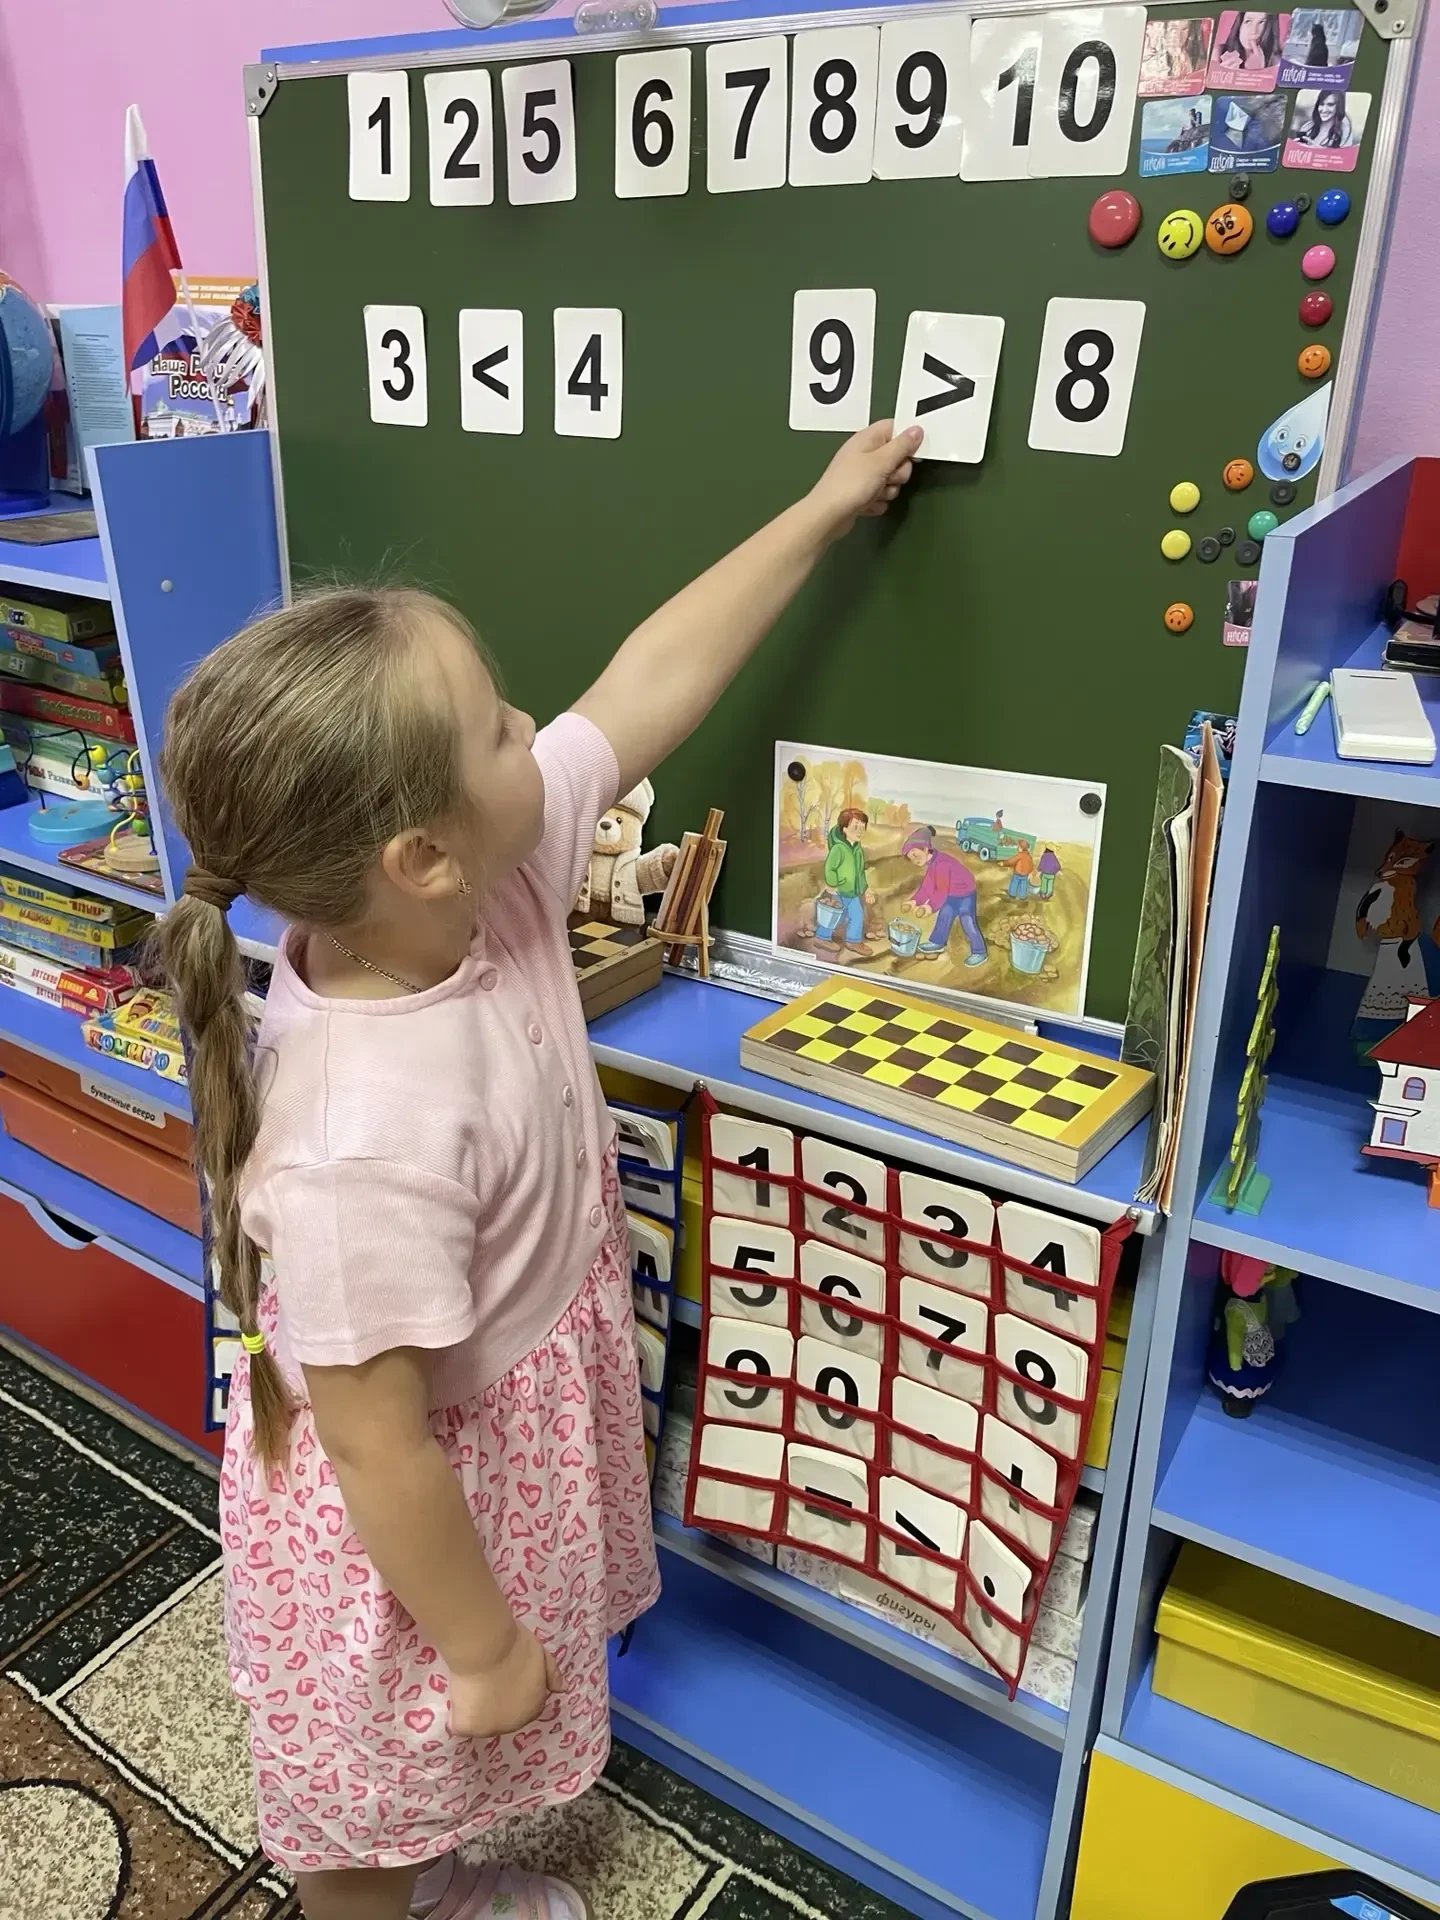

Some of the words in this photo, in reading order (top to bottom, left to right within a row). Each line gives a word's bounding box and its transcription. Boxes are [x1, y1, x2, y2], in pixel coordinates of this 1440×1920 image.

[367, 96, 392, 175] 1
[443, 98, 481, 179] 2
[521, 88, 562, 174] 5
[631, 78, 674, 167] 6
[724, 67, 771, 160] 7
[809, 58, 857, 153] 8
[894, 50, 948, 148] 9
[152, 353, 187, 376] Наша
[170, 374, 228, 400] Росся
[381, 328, 415, 401] 3
[567, 333, 609, 412] 4
[808, 318, 856, 405] 9
[1055, 328, 1115, 423] 8
[89, 1029, 170, 1071] ДОМИНО
[90, 1085, 131, 1111] буквенные
[738, 1146, 771, 1208] 1
[822, 1171, 868, 1240] 2
[919, 1204, 969, 1269] 3
[1022, 1241, 1078, 1312] 4
[729, 1246, 777, 1308] 5
[818, 1274, 863, 1337] 6
[918, 1304, 967, 1371] 7
[723, 1349, 772, 1409] 9
[875, 1592, 937, 1631] фигуры
